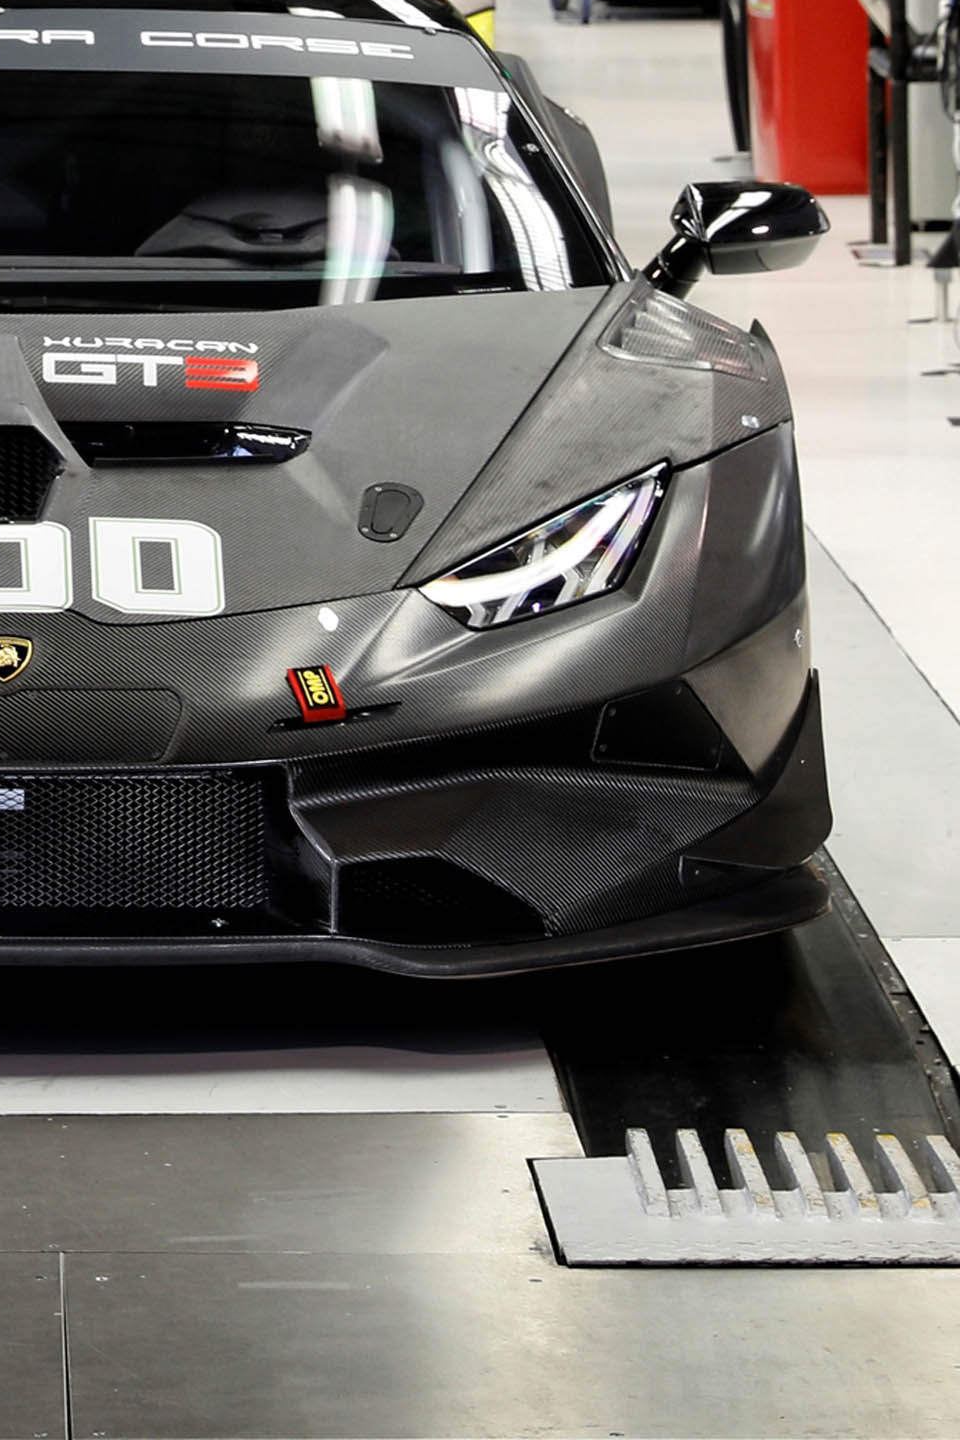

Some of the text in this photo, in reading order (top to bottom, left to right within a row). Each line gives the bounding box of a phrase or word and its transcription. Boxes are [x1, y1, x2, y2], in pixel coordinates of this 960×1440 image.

[141, 31, 415, 60] CORSE
[42, 351, 260, 392] GT3
[303, 669, 330, 705] OMP
